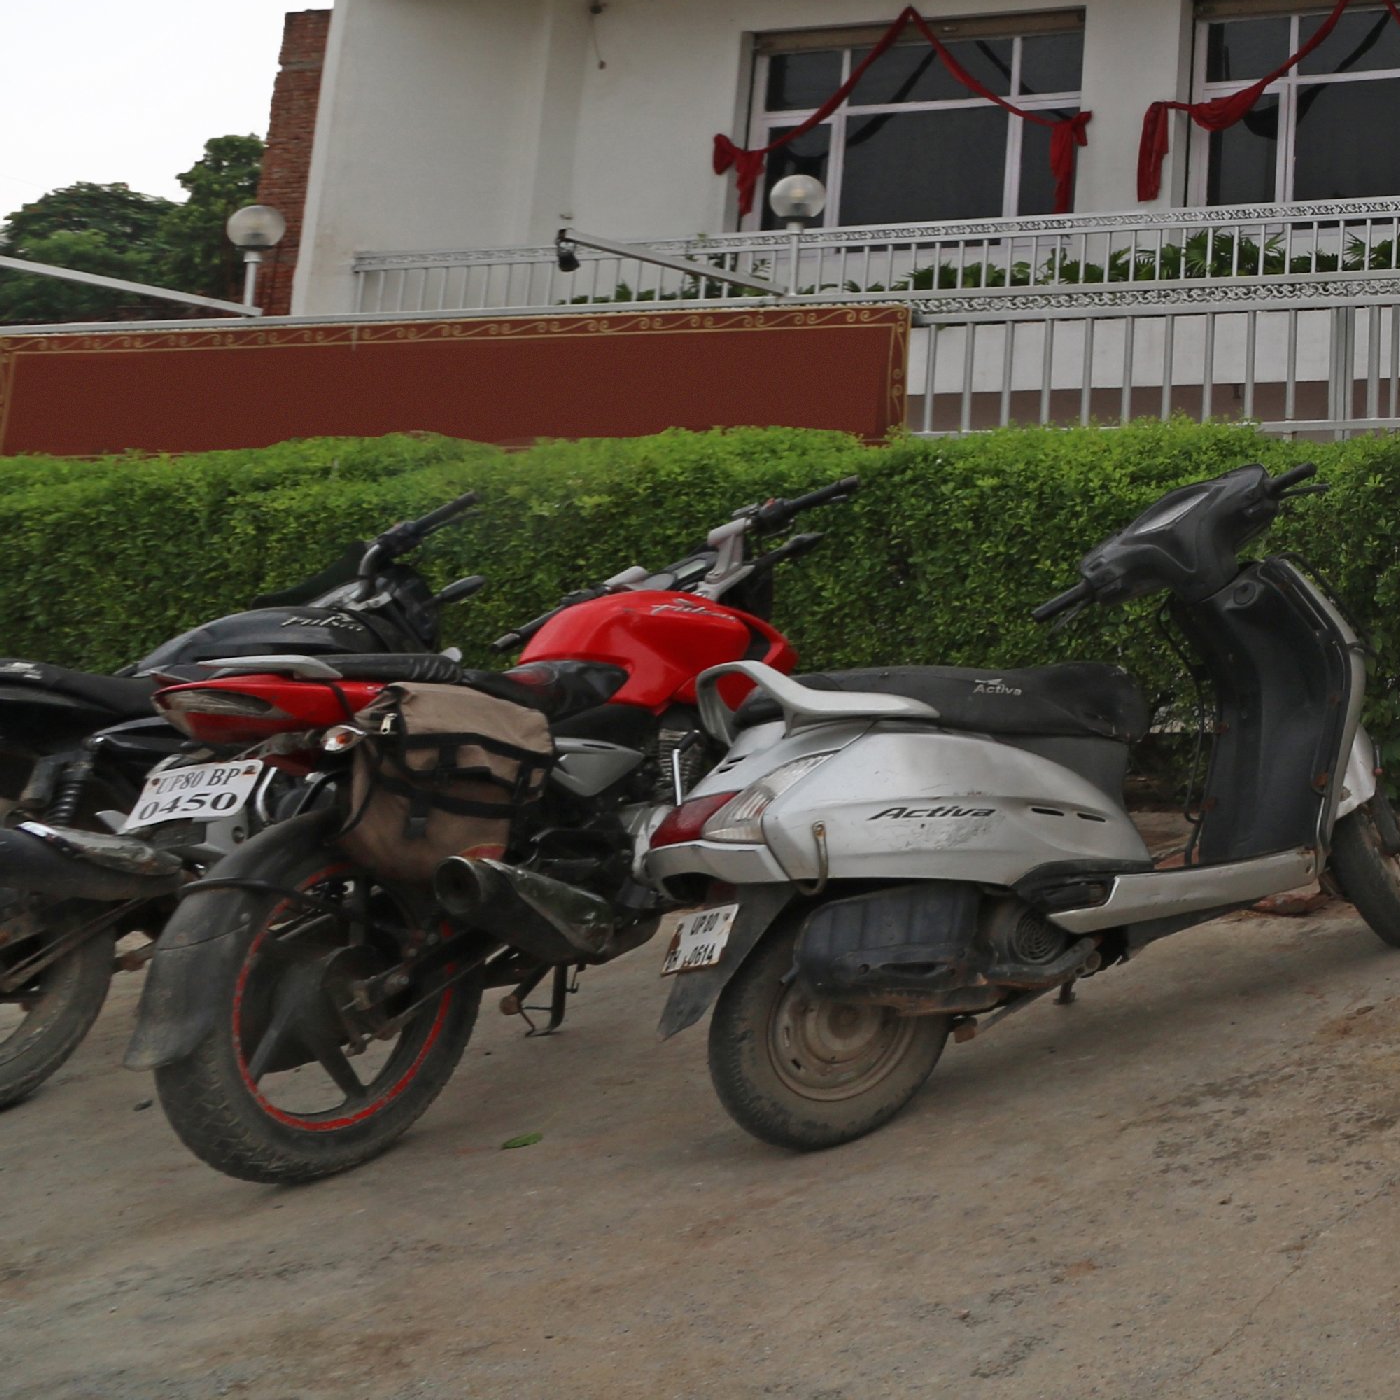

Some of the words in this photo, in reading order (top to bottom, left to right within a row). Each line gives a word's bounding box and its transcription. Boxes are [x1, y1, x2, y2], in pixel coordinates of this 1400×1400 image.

[972, 683, 1022, 696] Activa
[207, 768, 240, 787] BP
[138, 792, 238, 820] 0450
[866, 805, 996, 820] Activa
